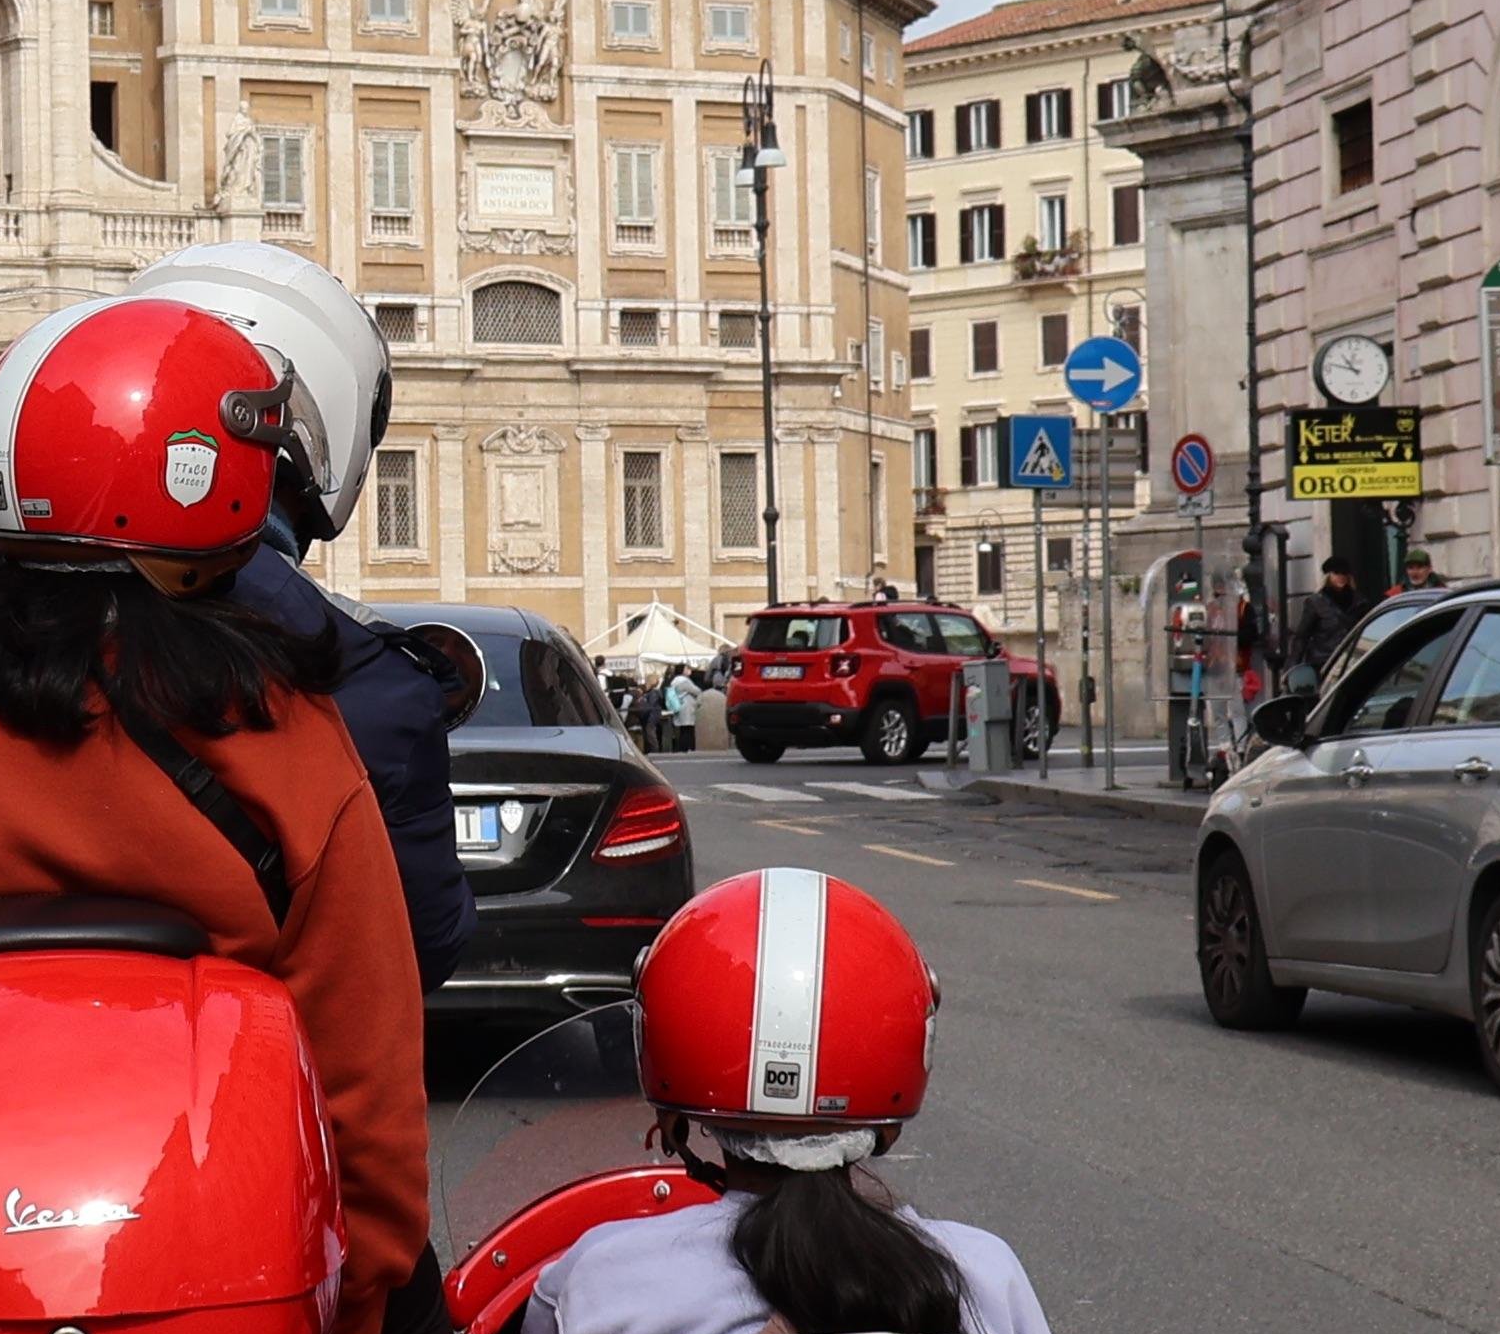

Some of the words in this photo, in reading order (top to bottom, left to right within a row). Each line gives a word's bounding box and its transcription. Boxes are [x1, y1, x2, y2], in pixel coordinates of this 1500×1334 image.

[1299, 419, 1352, 447] KETER
[1382, 441, 1398, 458] 7
[1299, 474, 1357, 495] ORO
[767, 1070, 798, 1086] DOT
